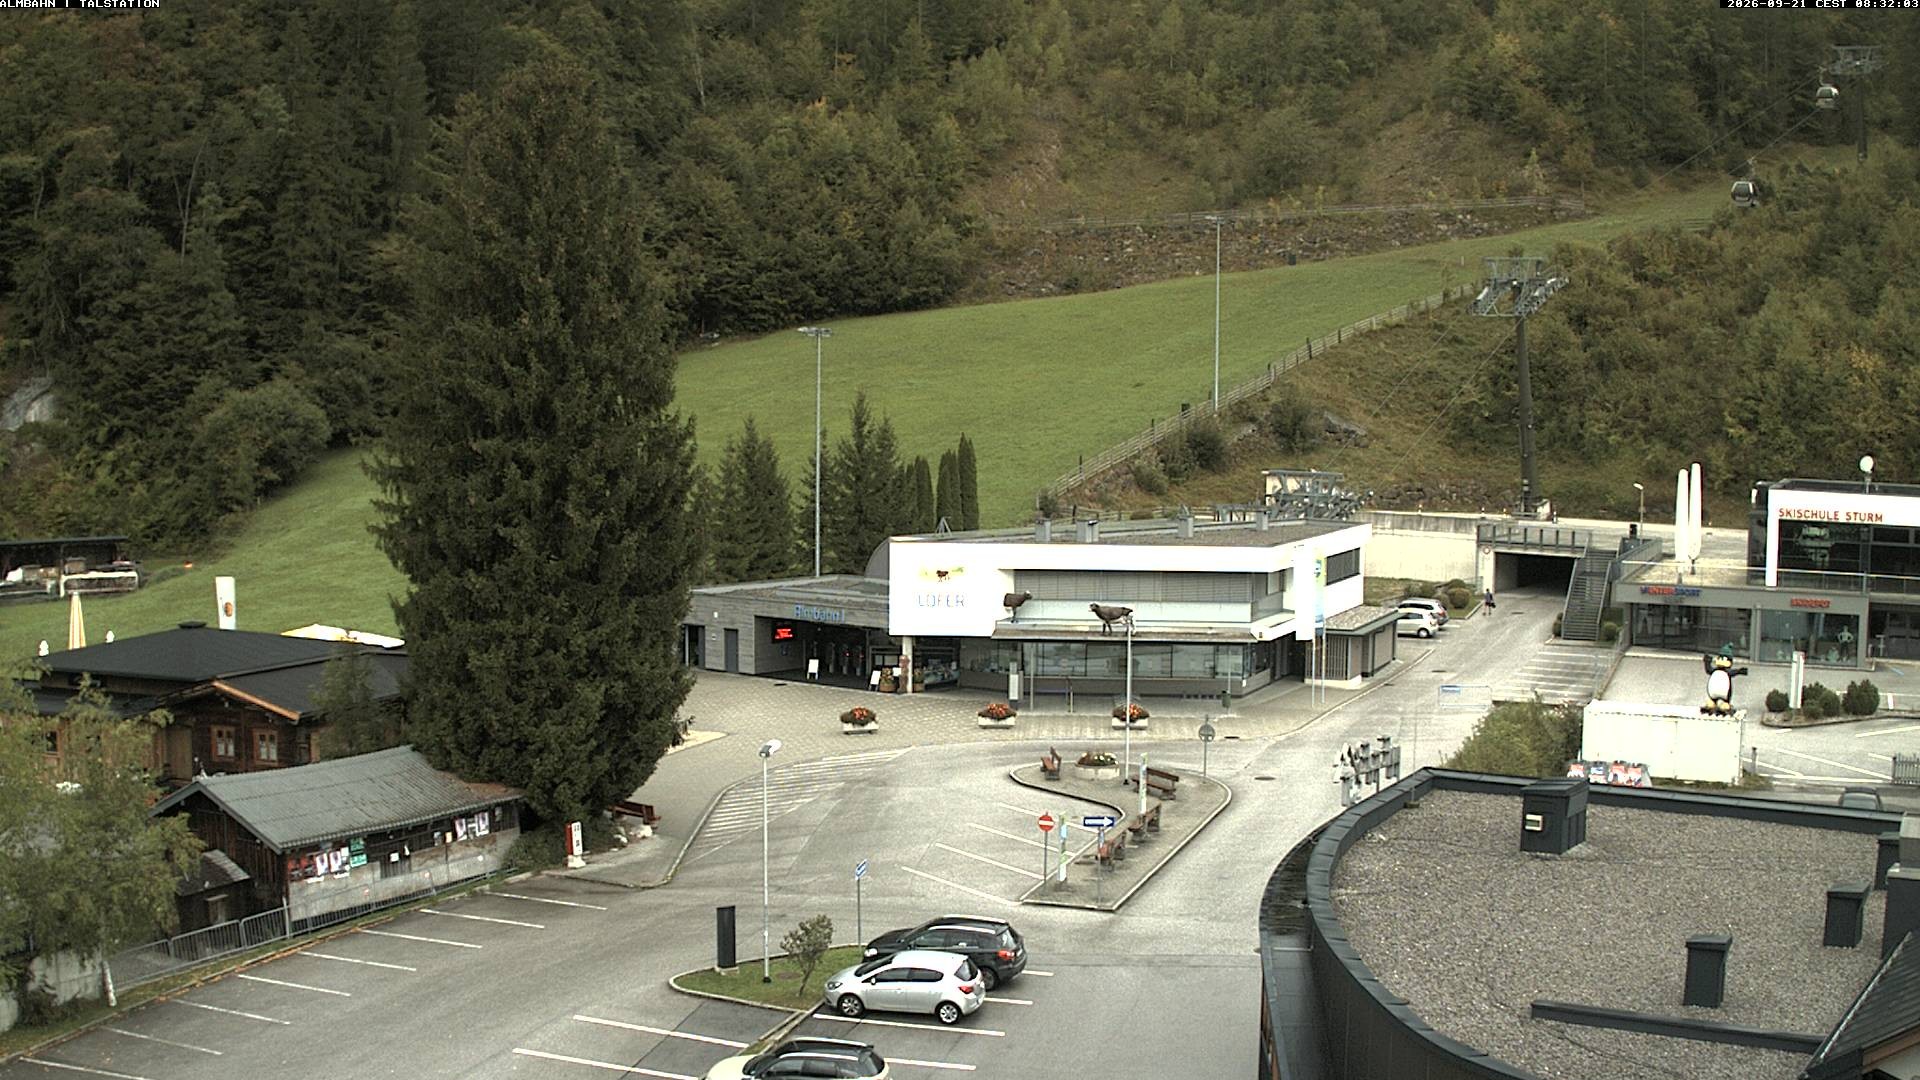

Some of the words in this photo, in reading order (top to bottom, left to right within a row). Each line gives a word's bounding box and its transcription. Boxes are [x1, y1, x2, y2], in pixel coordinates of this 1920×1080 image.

[1779, 508, 1839, 520] SKISCHULE
[1845, 511, 1883, 522] STURM
[917, 594, 965, 607] LOFER
